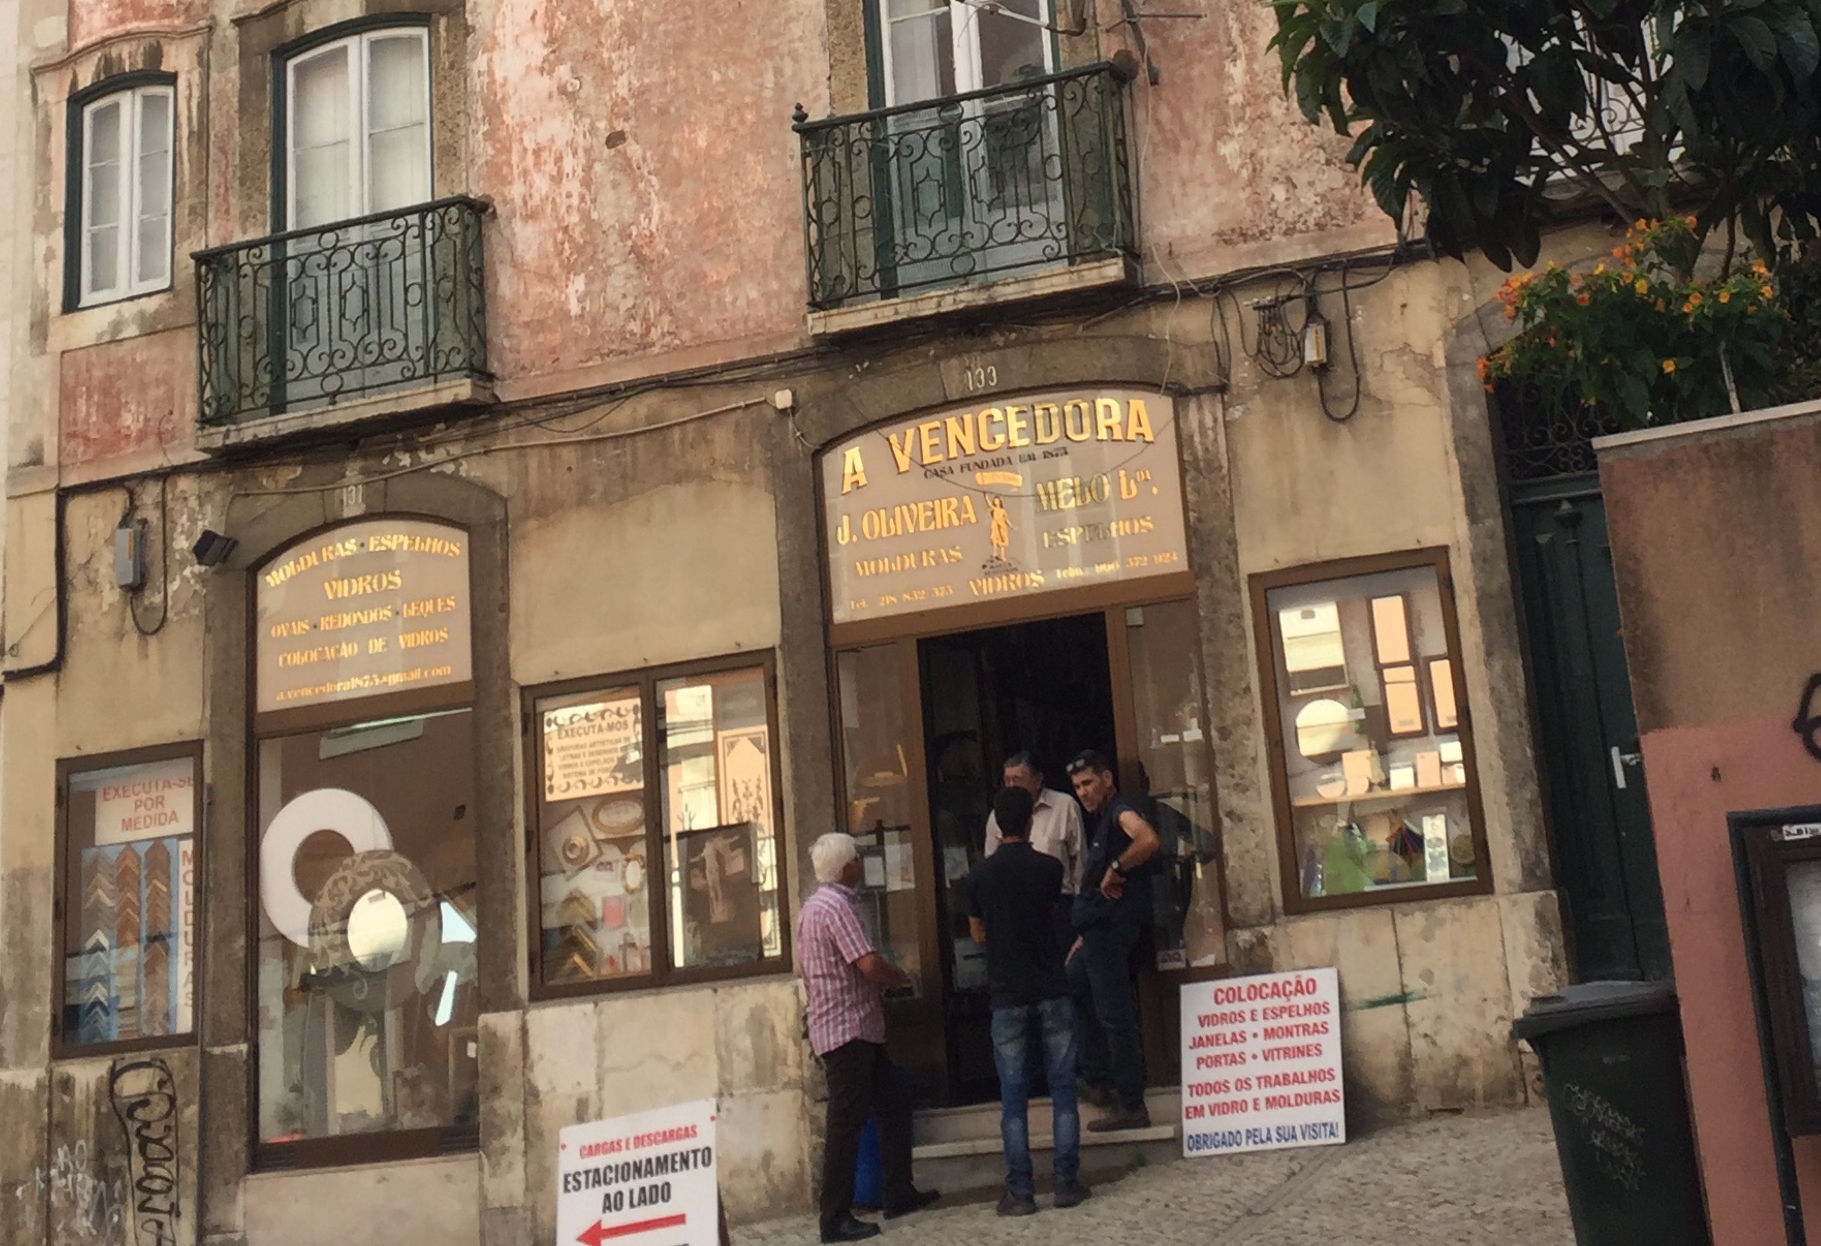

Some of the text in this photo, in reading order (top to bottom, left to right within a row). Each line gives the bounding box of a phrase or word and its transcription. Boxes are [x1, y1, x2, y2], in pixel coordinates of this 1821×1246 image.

[966, 365, 997, 391] 133
[841, 397, 1155, 495] A VENCEDORA
[923, 465, 955, 479] CASA
[960, 456, 1013, 473] FUNDADA
[1019, 451, 1036, 463] EM
[343, 484, 362, 504] 131
[835, 514, 858, 546] J.
[861, 494, 978, 541] OLIVEIRA
[1036, 473, 1110, 512] MELO
[1043, 515, 1154, 548] ESPELHOS
[265, 534, 461, 587] MOLDURAS ESPELHOS
[854, 545, 964, 577] MOLDURAS
[324, 569, 402, 600] VIDROS
[968, 569, 1046, 596] VIDROS
[271, 595, 456, 639] OVAIS REDONDOS LEQUES
[368, 637, 388, 655] DE
[399, 627, 449, 650] VIDROS
[135, 795, 166, 813] POR
[121, 810, 179, 832] MEDIDA
[1213, 975, 1317, 1005] COLOCAÇÃO
[1198, 1001, 1330, 1028] VIDROS E ESPELHOS
[1189, 1021, 1329, 1050] JANELAS MONTRAS
[1196, 1043, 1323, 1070] PORTAS VITRINES
[1187, 1068, 1335, 1098] TODOS OS TRABALHOS
[1185, 1089, 1340, 1120] EM VIDRO E MOLDURAS
[579, 1124, 698, 1160] CARGAS E DESCARGAS
[1187, 1121, 1339, 1152] OBRIGADO PELA SUA VISITA!
[563, 1146, 712, 1194] ESTACIONAMENTO
[602, 1181, 671, 1214] AO LADO
